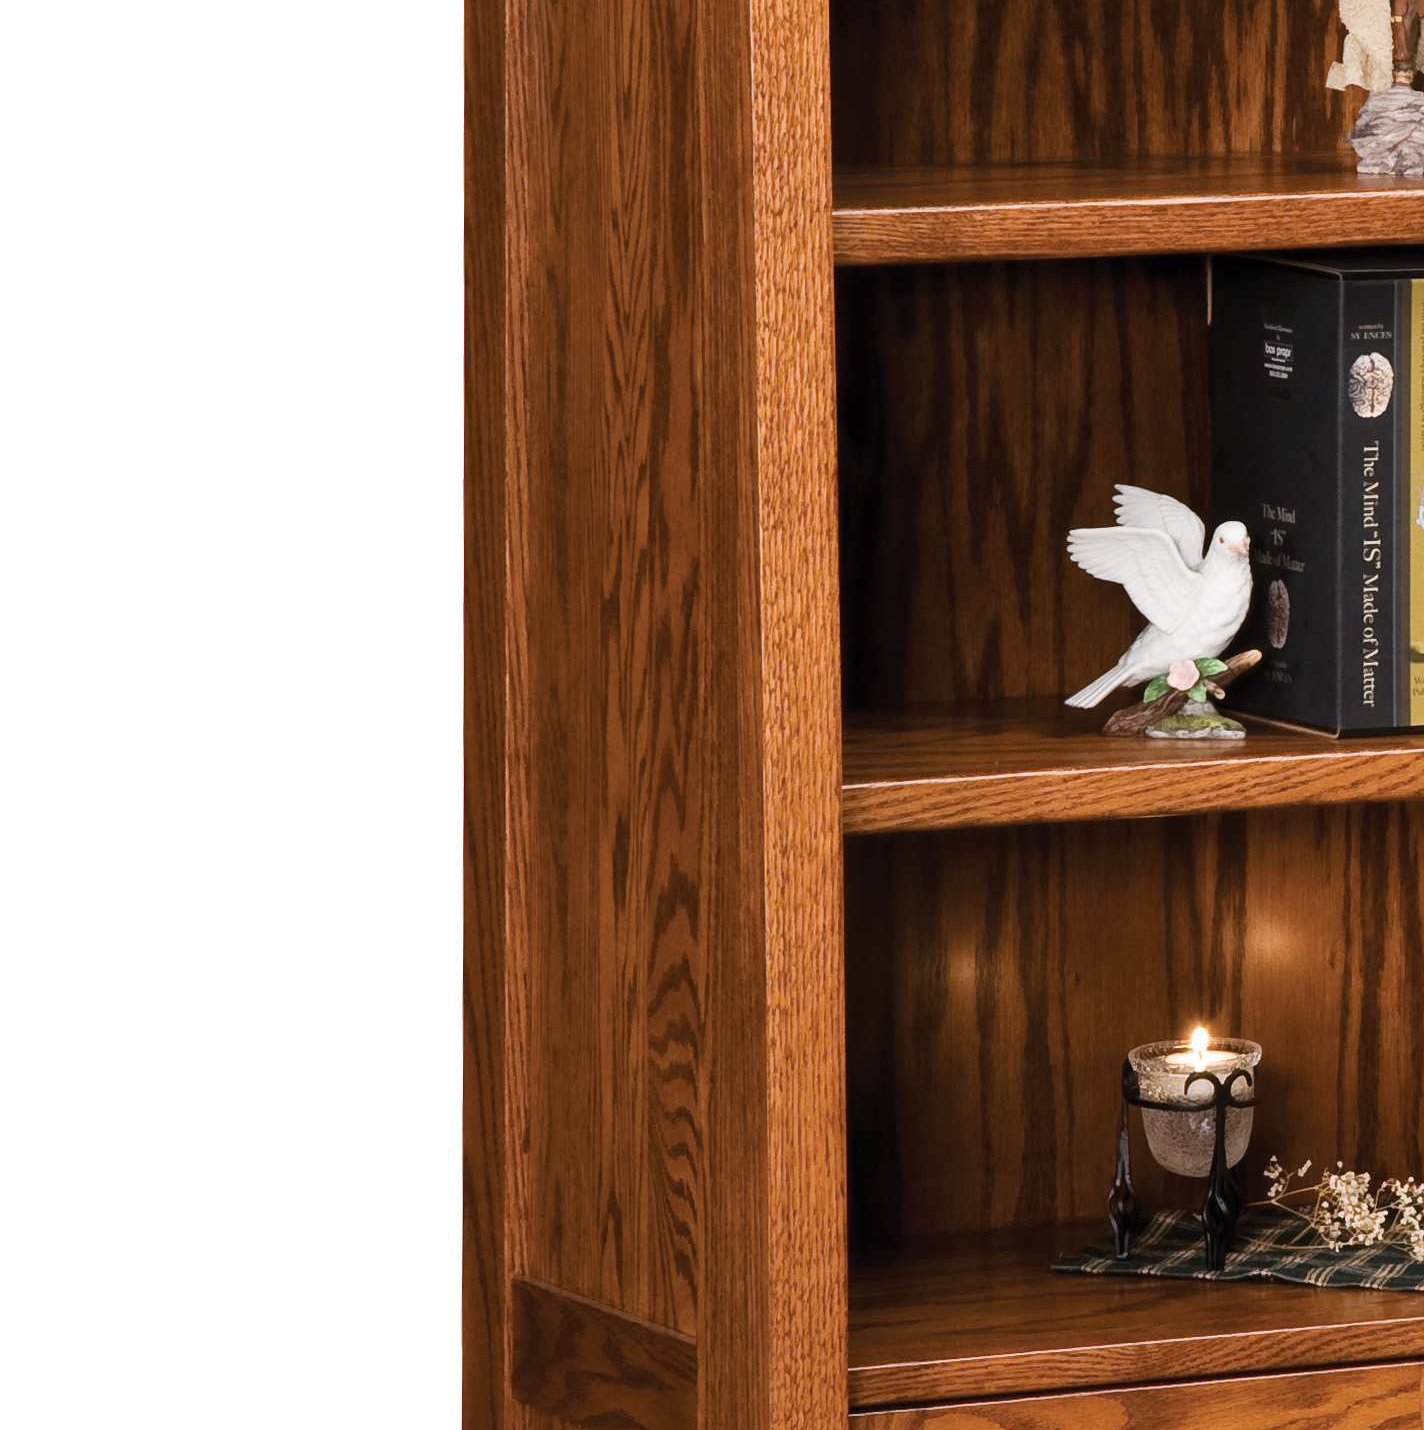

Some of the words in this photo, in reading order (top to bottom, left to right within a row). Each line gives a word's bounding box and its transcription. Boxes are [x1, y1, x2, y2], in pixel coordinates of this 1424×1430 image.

[1363, 440, 1379, 477] The
[1363, 481, 1380, 528] Mind
[1363, 574, 1379, 624] Made
[1363, 626, 1379, 646] of
[1363, 648, 1379, 707] Matter
